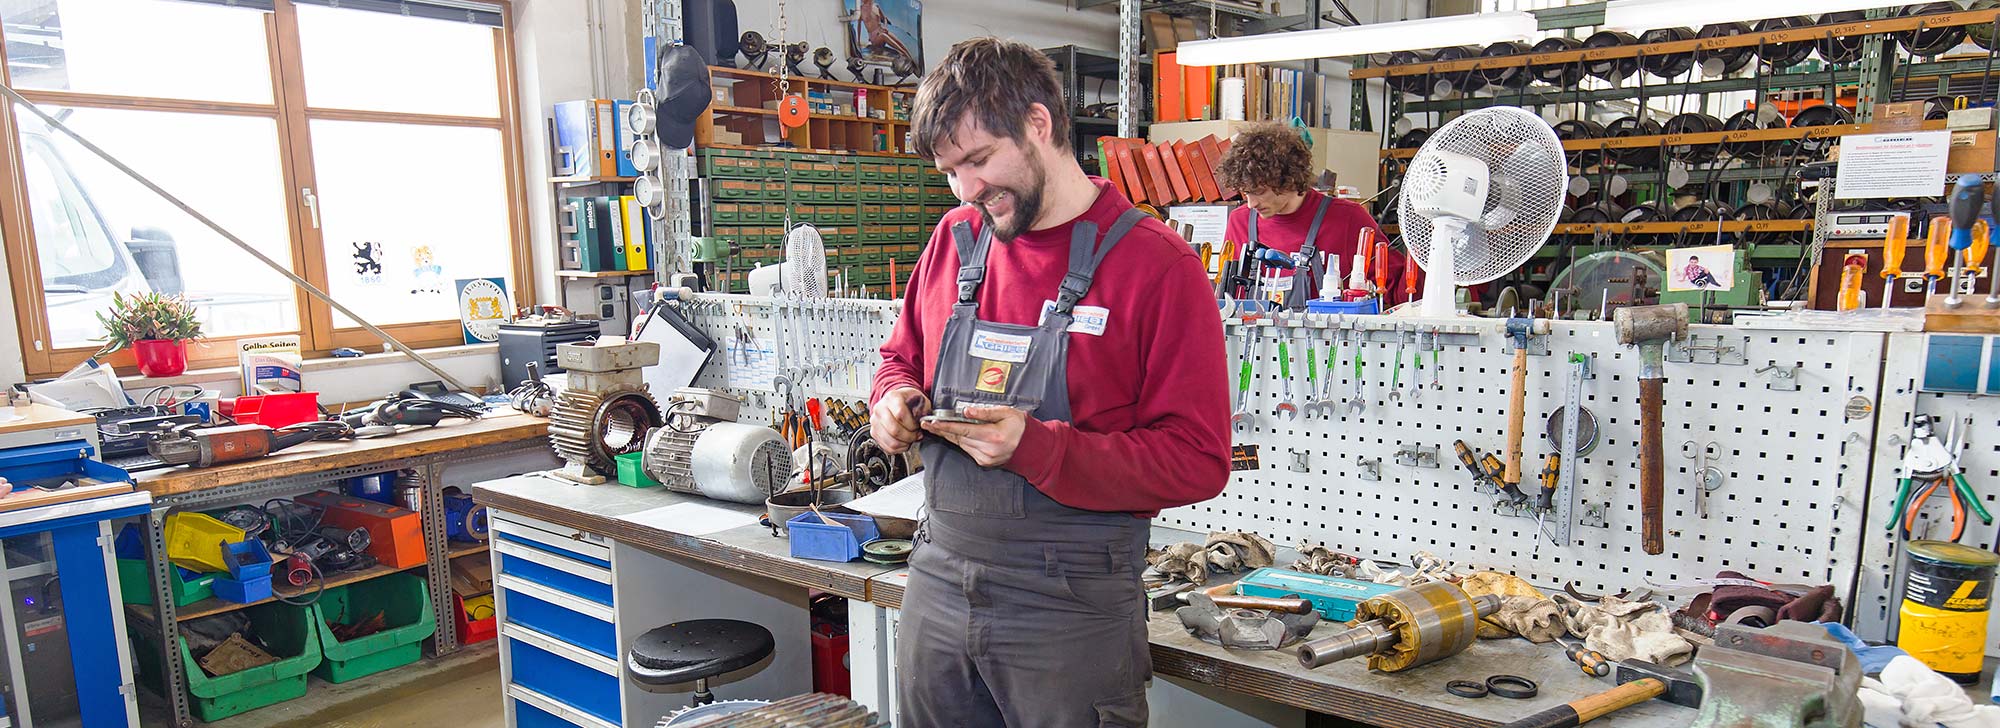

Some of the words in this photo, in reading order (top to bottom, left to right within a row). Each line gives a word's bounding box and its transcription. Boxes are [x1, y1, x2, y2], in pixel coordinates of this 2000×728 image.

[1814, 127, 1830, 136] 0,60
[586, 201, 594, 229] metabo
[464, 281, 501, 295] Bayern
[269, 341, 297, 349] Seiten
